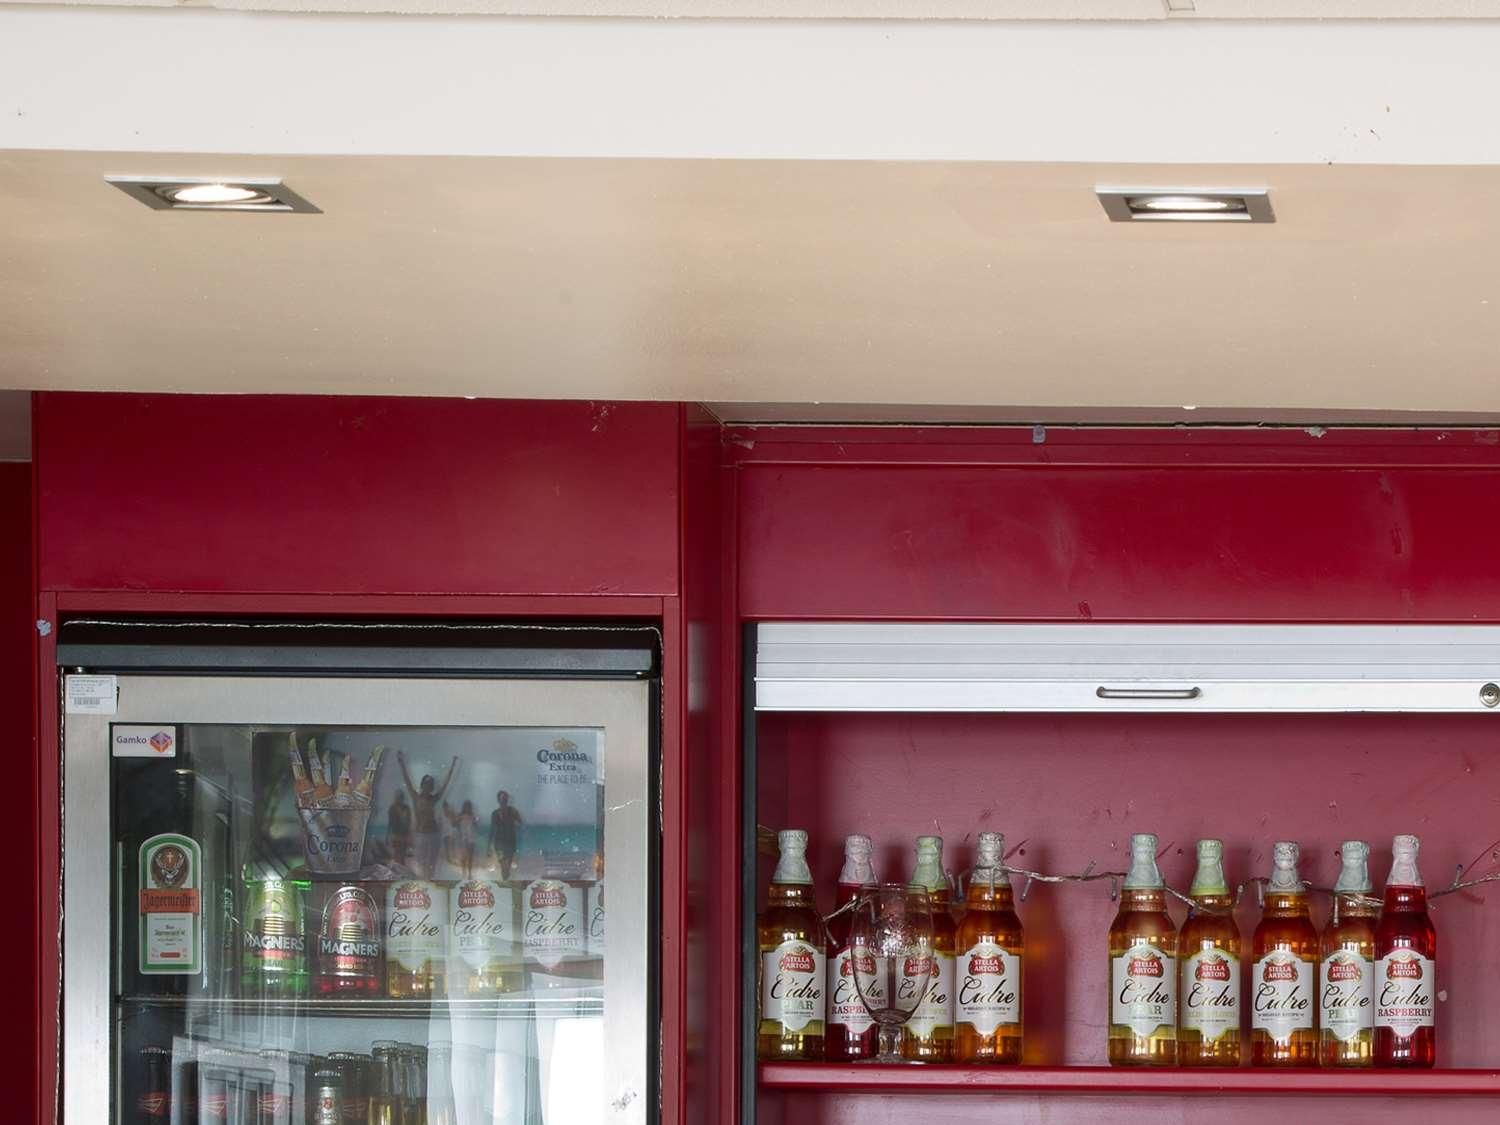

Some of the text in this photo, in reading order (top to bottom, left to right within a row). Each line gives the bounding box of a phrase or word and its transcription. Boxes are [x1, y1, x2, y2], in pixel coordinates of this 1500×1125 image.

[117, 735, 147, 744] Gamko
[537, 749, 589, 763] Corona
[307, 834, 359, 854] Corona
[388, 912, 440, 938] Cidre
[454, 910, 504, 937] Cidre
[525, 910, 575, 937] Cidre
[243, 934, 304, 950] MAGNERS
[321, 940, 378, 956] MAGNERS
[771, 974, 821, 999] Cidre
[959, 976, 1015, 1004] Cidre
[1120, 979, 1169, 1004] Cidre
[1188, 983, 1236, 1008] Cidre
[1255, 983, 1308, 1011] Cidre
[1323, 984, 1370, 1009] Cidre
[1380, 982, 1429, 1006] Cidre
